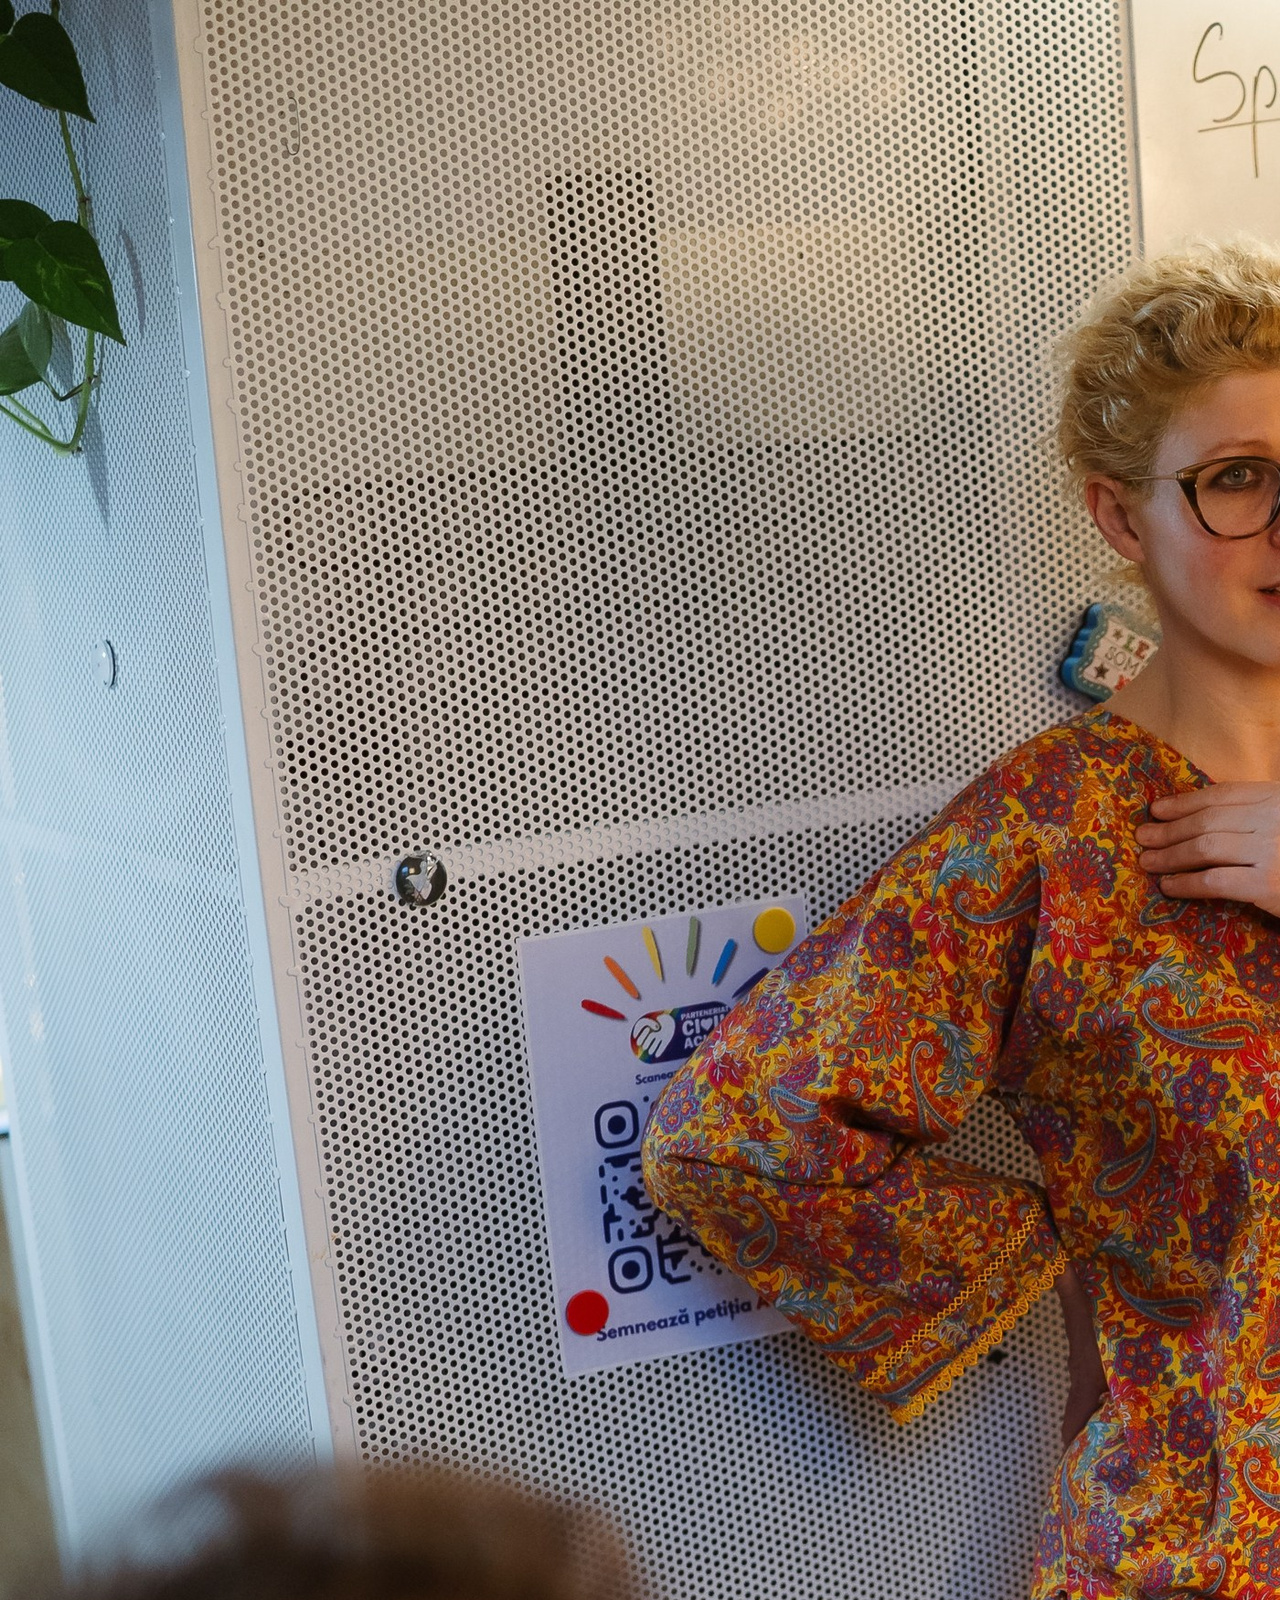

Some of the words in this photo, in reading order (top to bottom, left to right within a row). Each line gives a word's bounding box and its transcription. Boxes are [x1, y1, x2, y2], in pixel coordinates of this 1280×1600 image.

[684, 1034, 707, 1050] AC
[635, 1070, 677, 1086] Scanea
[596, 1307, 690, 1342] Semnează
